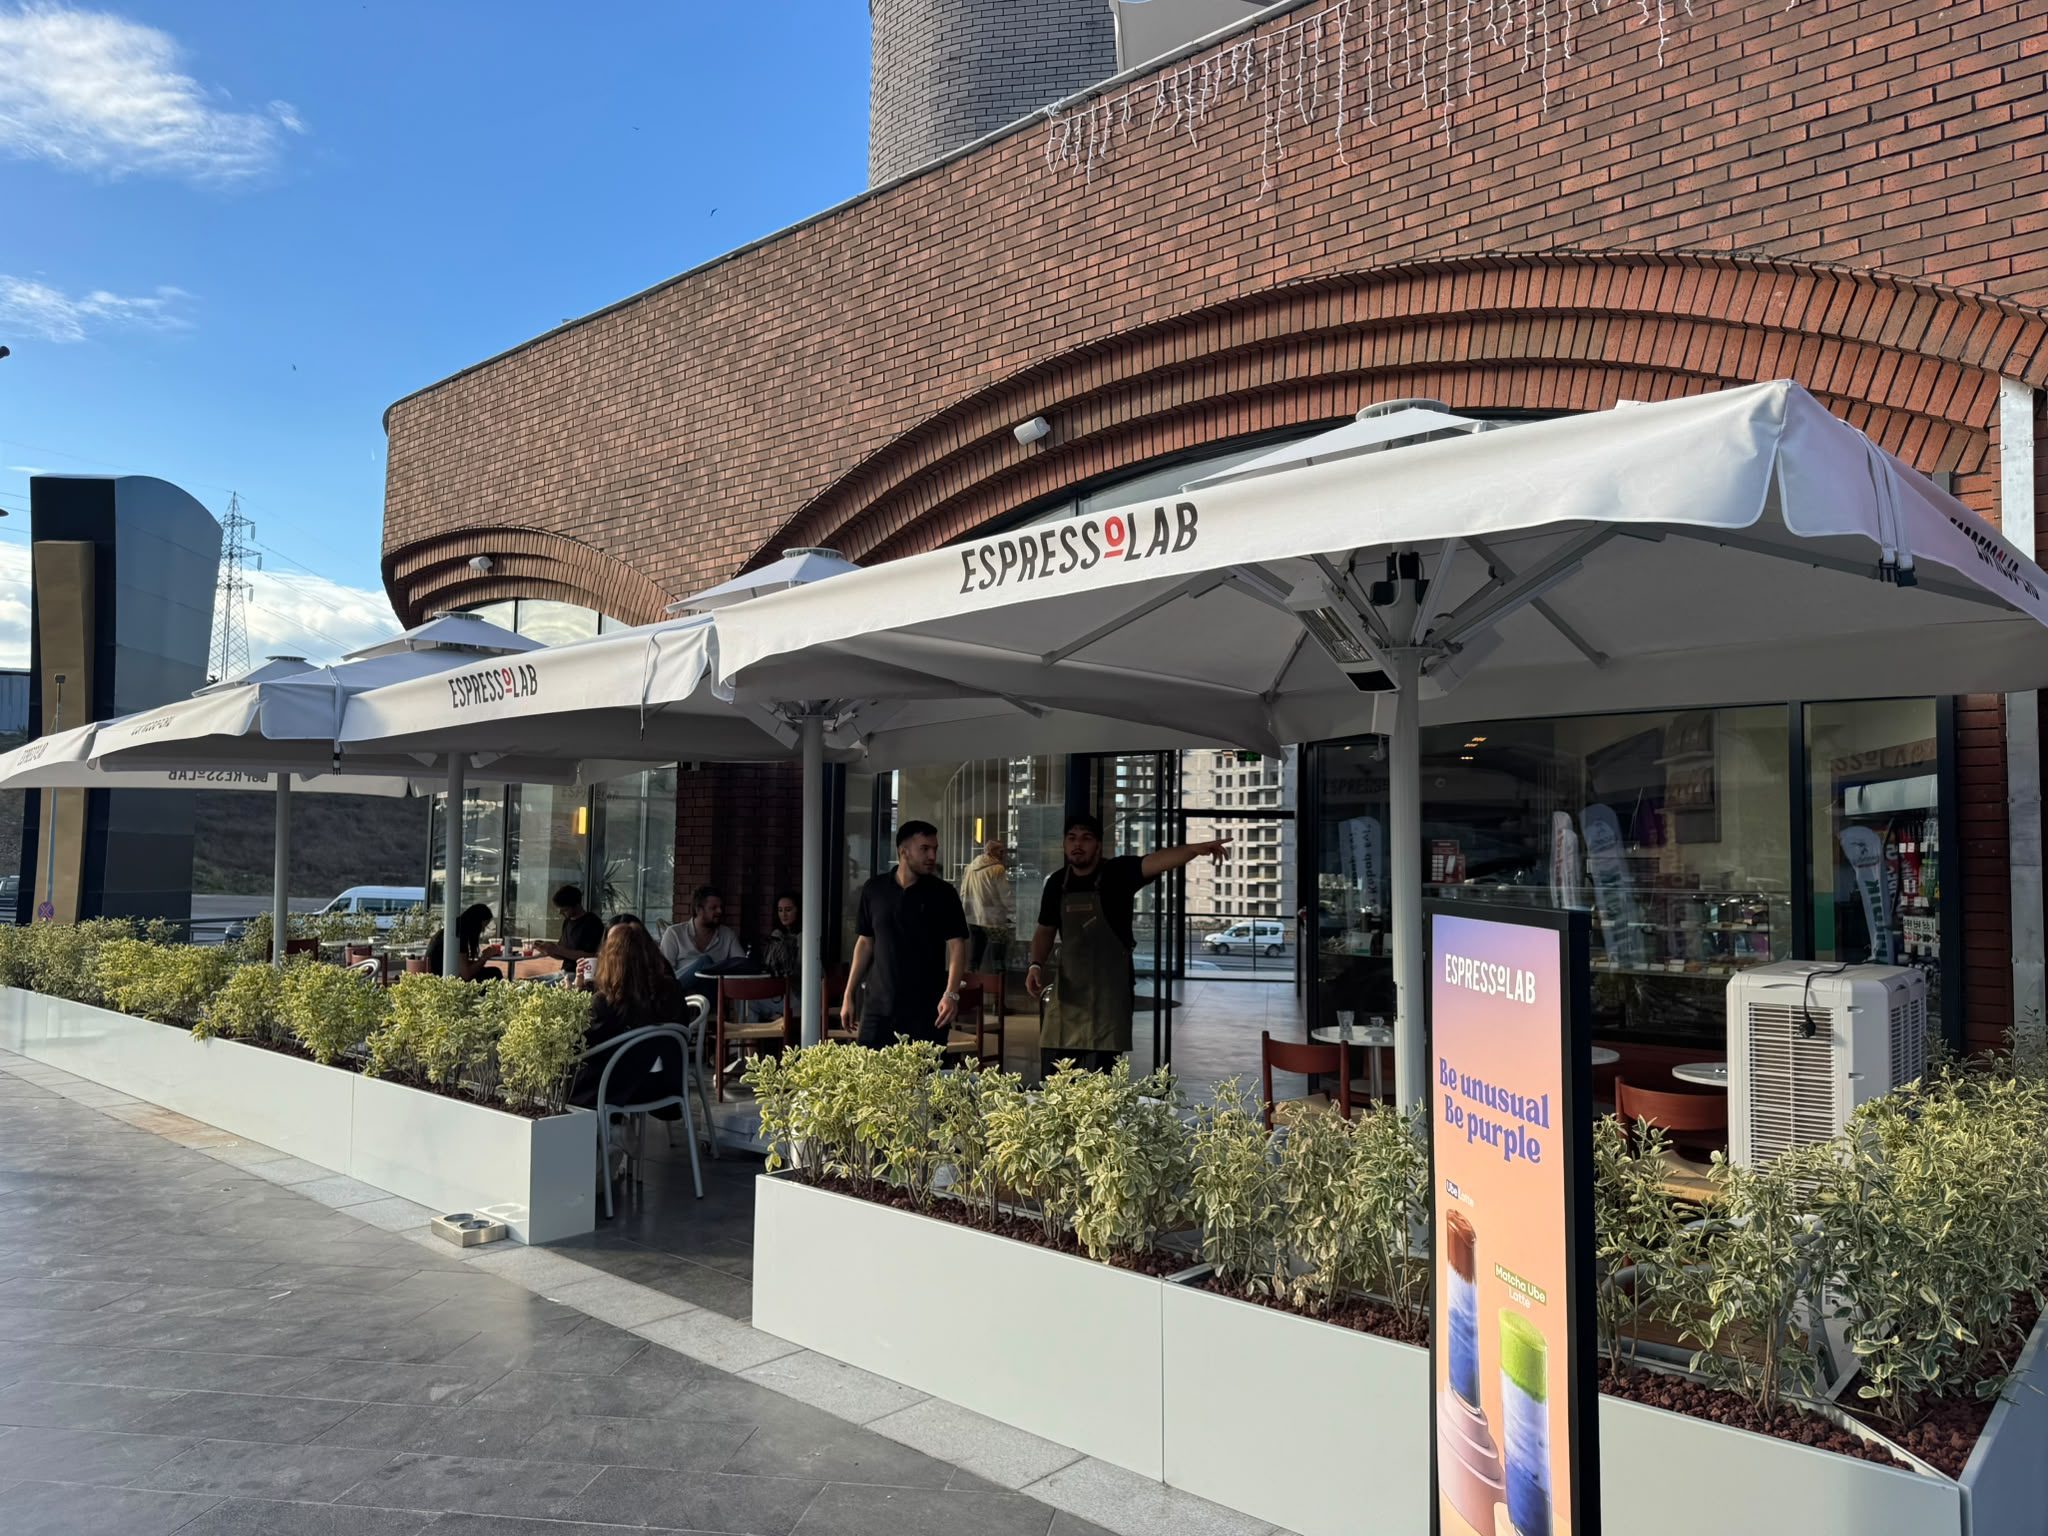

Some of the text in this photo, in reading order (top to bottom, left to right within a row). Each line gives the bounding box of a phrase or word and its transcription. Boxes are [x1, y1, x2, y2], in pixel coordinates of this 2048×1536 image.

[960, 502, 1199, 594] ESPRESSOLAB
[448, 664, 538, 708] ESPRESSOLAB
[1445, 953, 1536, 1004] ESPRESSOLAB
[1439, 1057, 1550, 1129] Be unusual
[1444, 1094, 1541, 1164] Be purple
[1446, 1180, 1458, 1198] Ube
[1495, 1263, 1546, 1303] Matcha Ube
[1508, 1287, 1531, 1309] Latte
